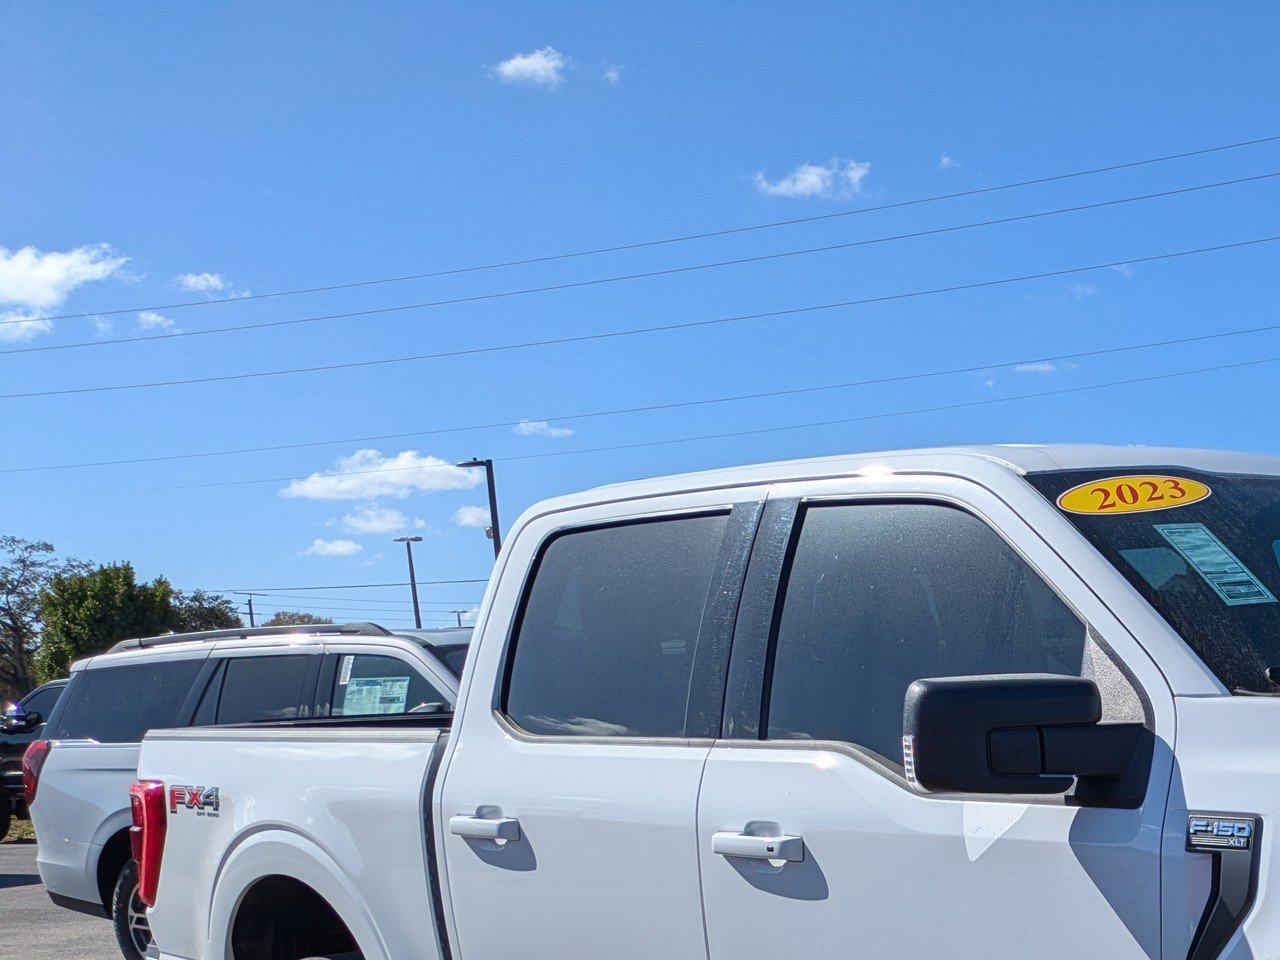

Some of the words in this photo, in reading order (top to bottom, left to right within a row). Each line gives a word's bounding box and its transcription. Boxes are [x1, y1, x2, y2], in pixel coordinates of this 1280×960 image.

[1091, 479, 1186, 510] 2023
[169, 785, 219, 813] FX4
[1190, 821, 1251, 838] F-150
[1228, 838, 1245, 846] XLT
